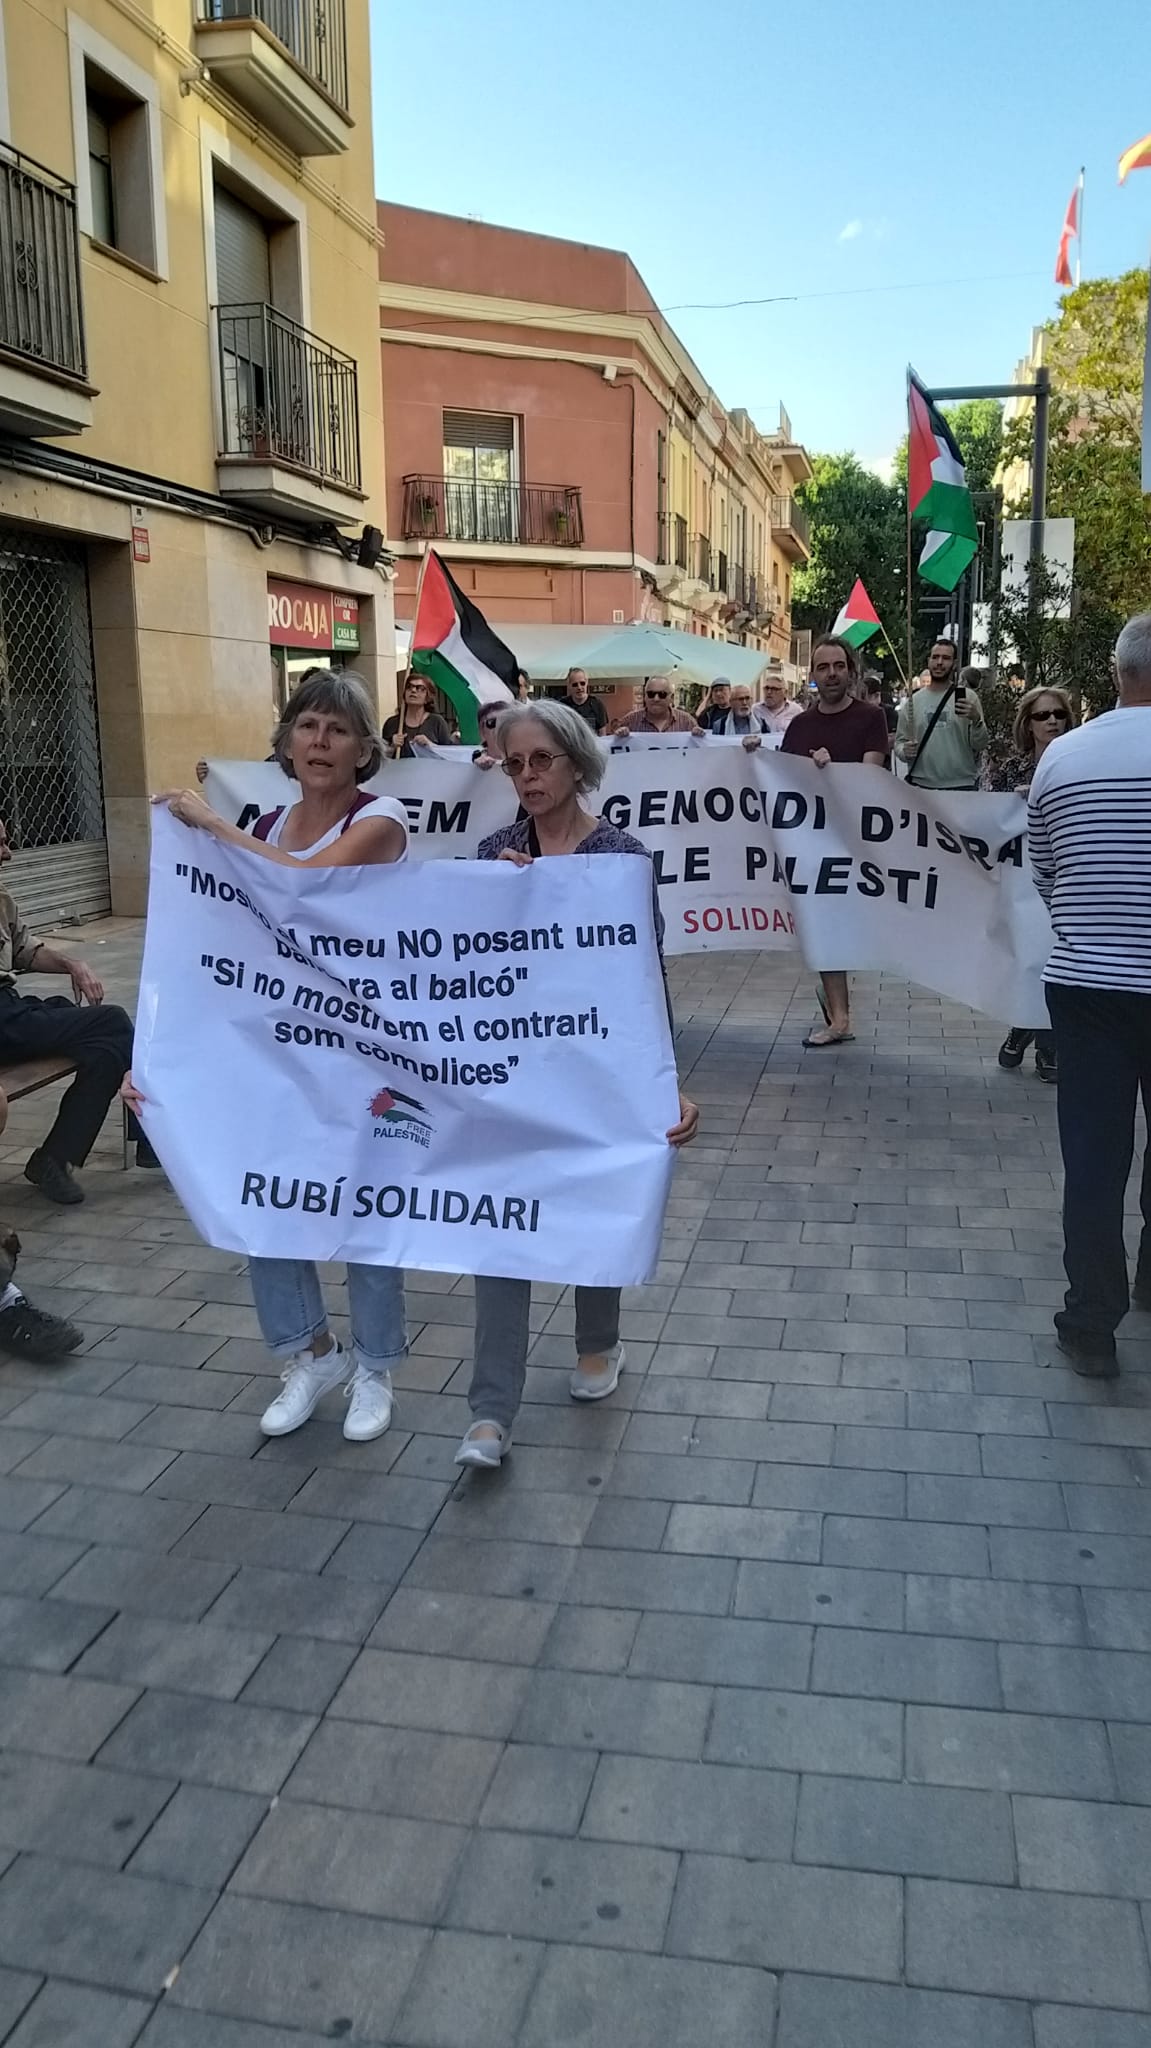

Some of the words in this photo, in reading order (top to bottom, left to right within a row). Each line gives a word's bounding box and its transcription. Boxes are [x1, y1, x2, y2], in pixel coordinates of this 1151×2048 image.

[601, 787, 826, 829] GENOCIDI
[746, 846, 939, 909] PALESTÍ
[310, 935, 385, 958] meu
[397, 928, 442, 960] NO
[453, 922, 564, 961] posant
[576, 923, 638, 947] una
[200, 954, 245, 988] "Si
[253, 972, 286, 1000] no
[292, 985, 430, 1041] mostrem
[438, 1016, 465, 1042] el
[473, 1007, 609, 1041] contrari,
[390, 974, 418, 1000] al
[429, 966, 528, 1001] balcó"
[274, 1021, 345, 1049] som
[355, 1041, 519, 1085] còmplices”
[373, 1128, 431, 1148] PALESTINE
[406, 1122, 432, 1138] FREE
[241, 1171, 347, 1216] RUBÍ
[353, 1185, 540, 1232] SOLIDARI
